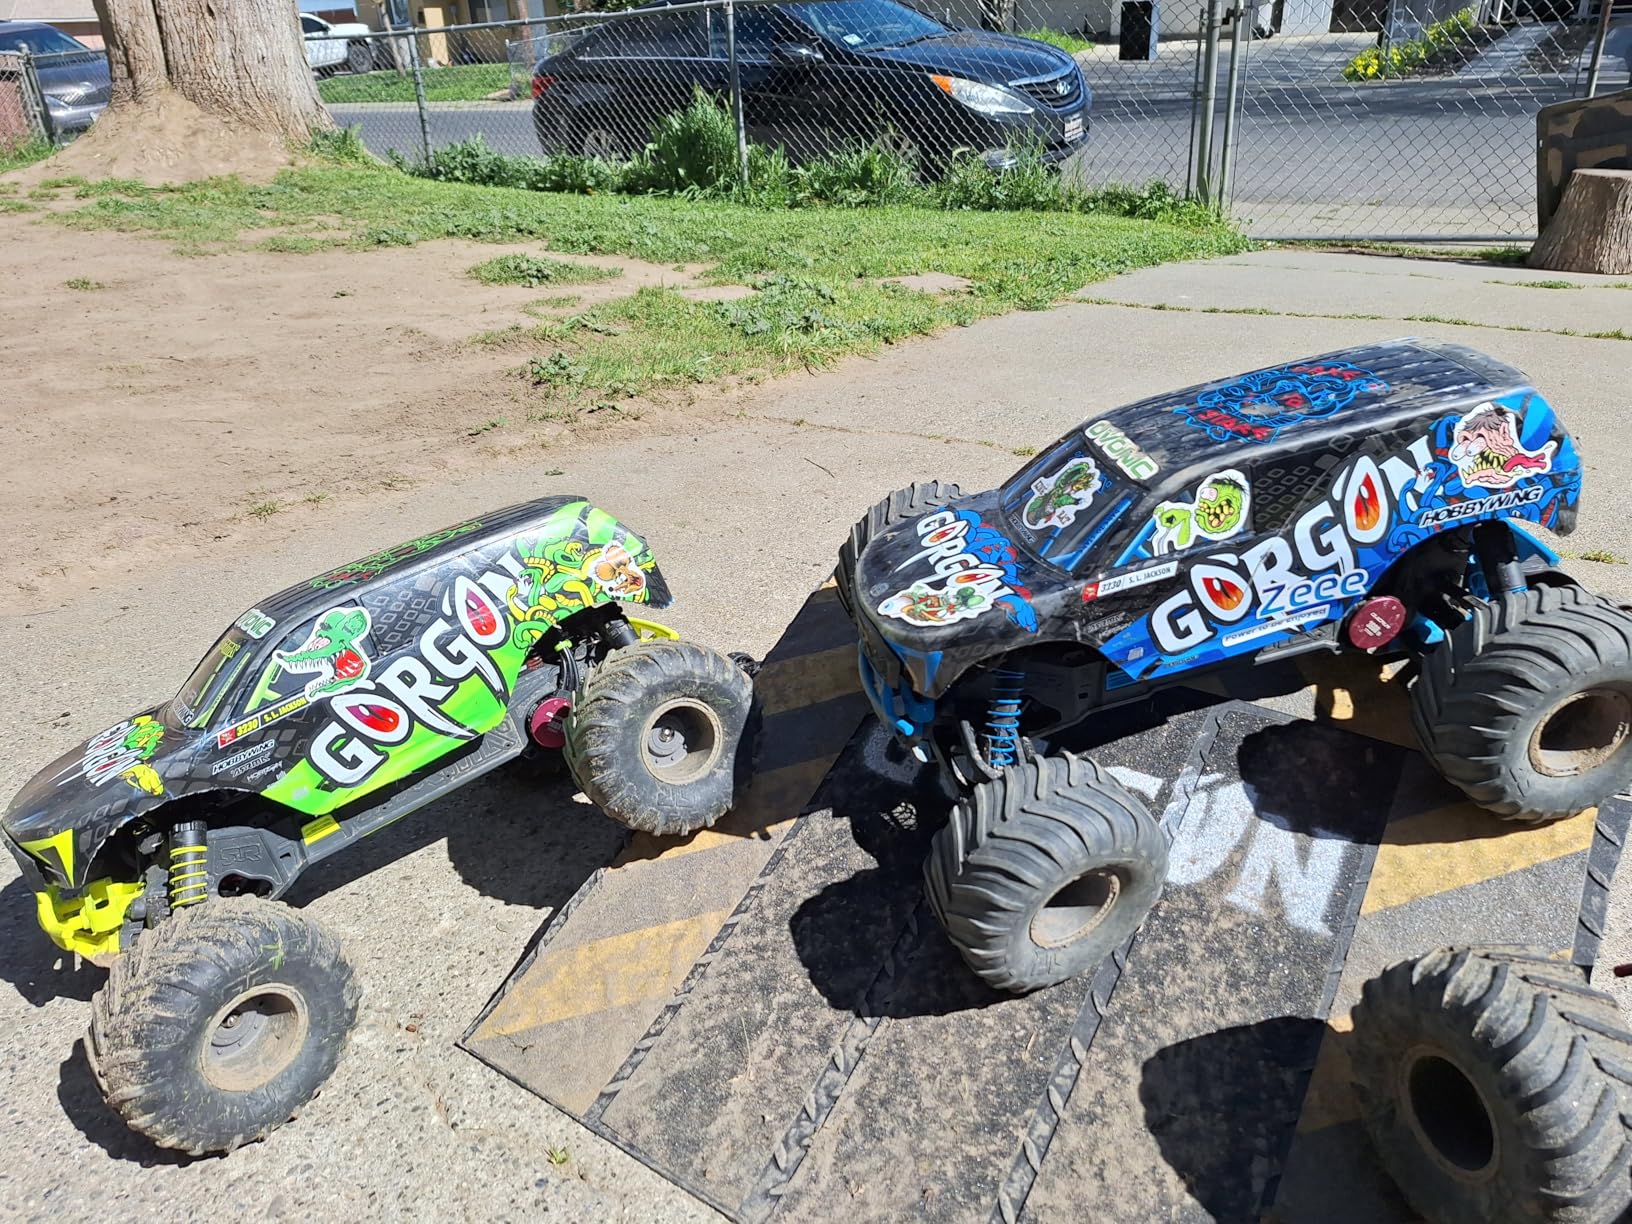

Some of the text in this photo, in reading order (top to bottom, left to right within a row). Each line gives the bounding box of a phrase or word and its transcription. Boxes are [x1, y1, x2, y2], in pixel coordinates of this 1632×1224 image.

[1420, 487, 1542, 528] HOBBYWING
[895, 511, 1015, 600] GORGON
[1151, 434, 1444, 652] GORGON
[1143, 566, 1171, 580] JACKSON
[310, 551, 530, 785] GORGON
[236, 716, 258, 737] 3230
[279, 696, 308, 715] JACKSON
[212, 739, 275, 776] HOBBYWING
